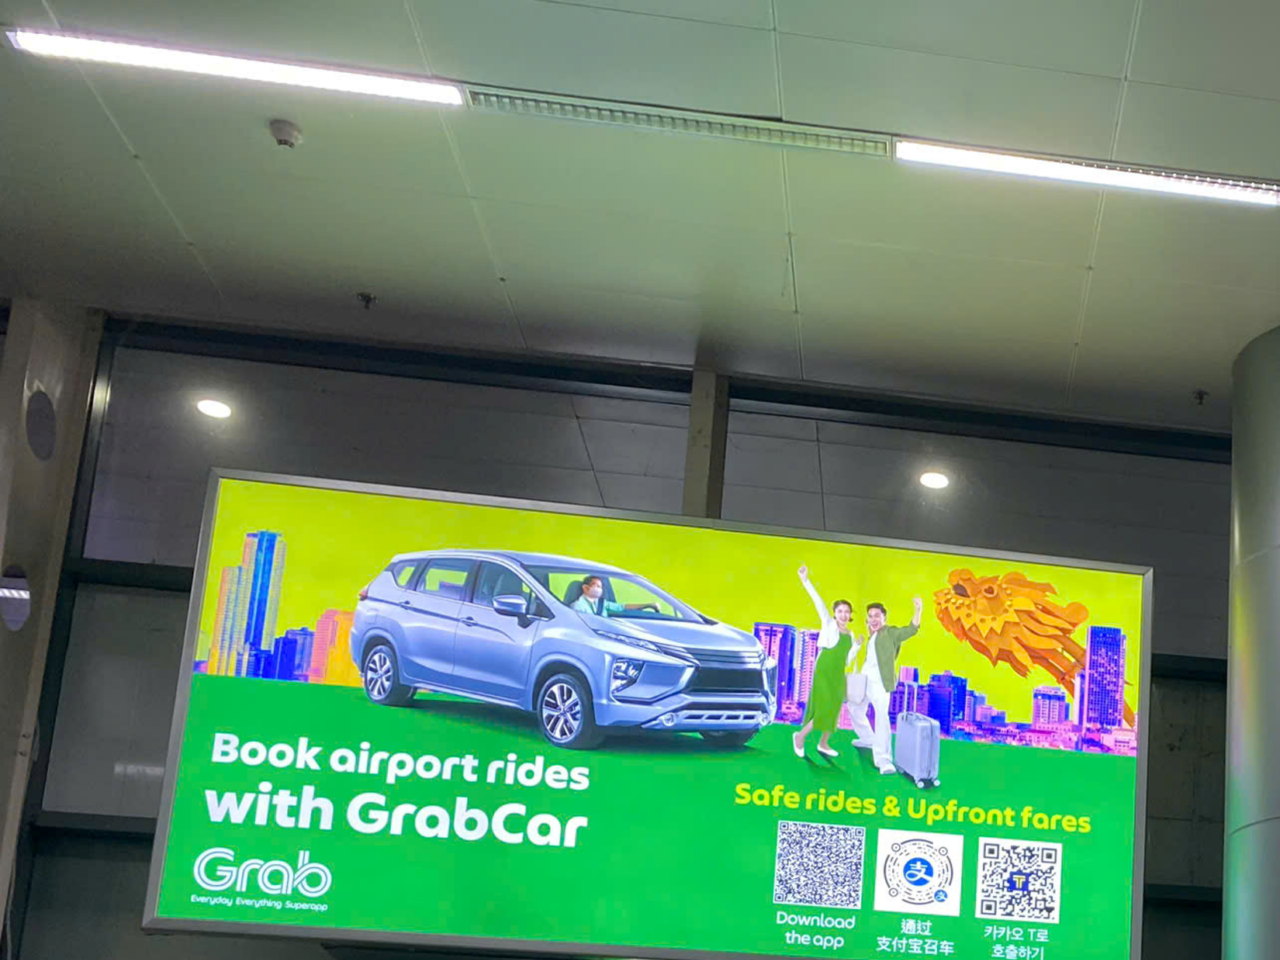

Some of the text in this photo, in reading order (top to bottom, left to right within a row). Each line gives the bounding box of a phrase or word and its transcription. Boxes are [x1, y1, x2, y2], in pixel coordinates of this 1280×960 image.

[211, 733, 589, 790] Book airport rides
[205, 781, 588, 847] with GrabCar
[735, 783, 1091, 833] Safe rides & Upfront fares
[193, 847, 332, 898] Grab
[191, 894, 232, 907] Everyday
[236, 897, 283, 909] Everything
[776, 911, 855, 929] Download
[901, 918, 932, 936] 通过
[785, 931, 845, 949] the app
[984, 925, 1024, 941] 카카오
[876, 936, 954, 956] 支付宝召车
